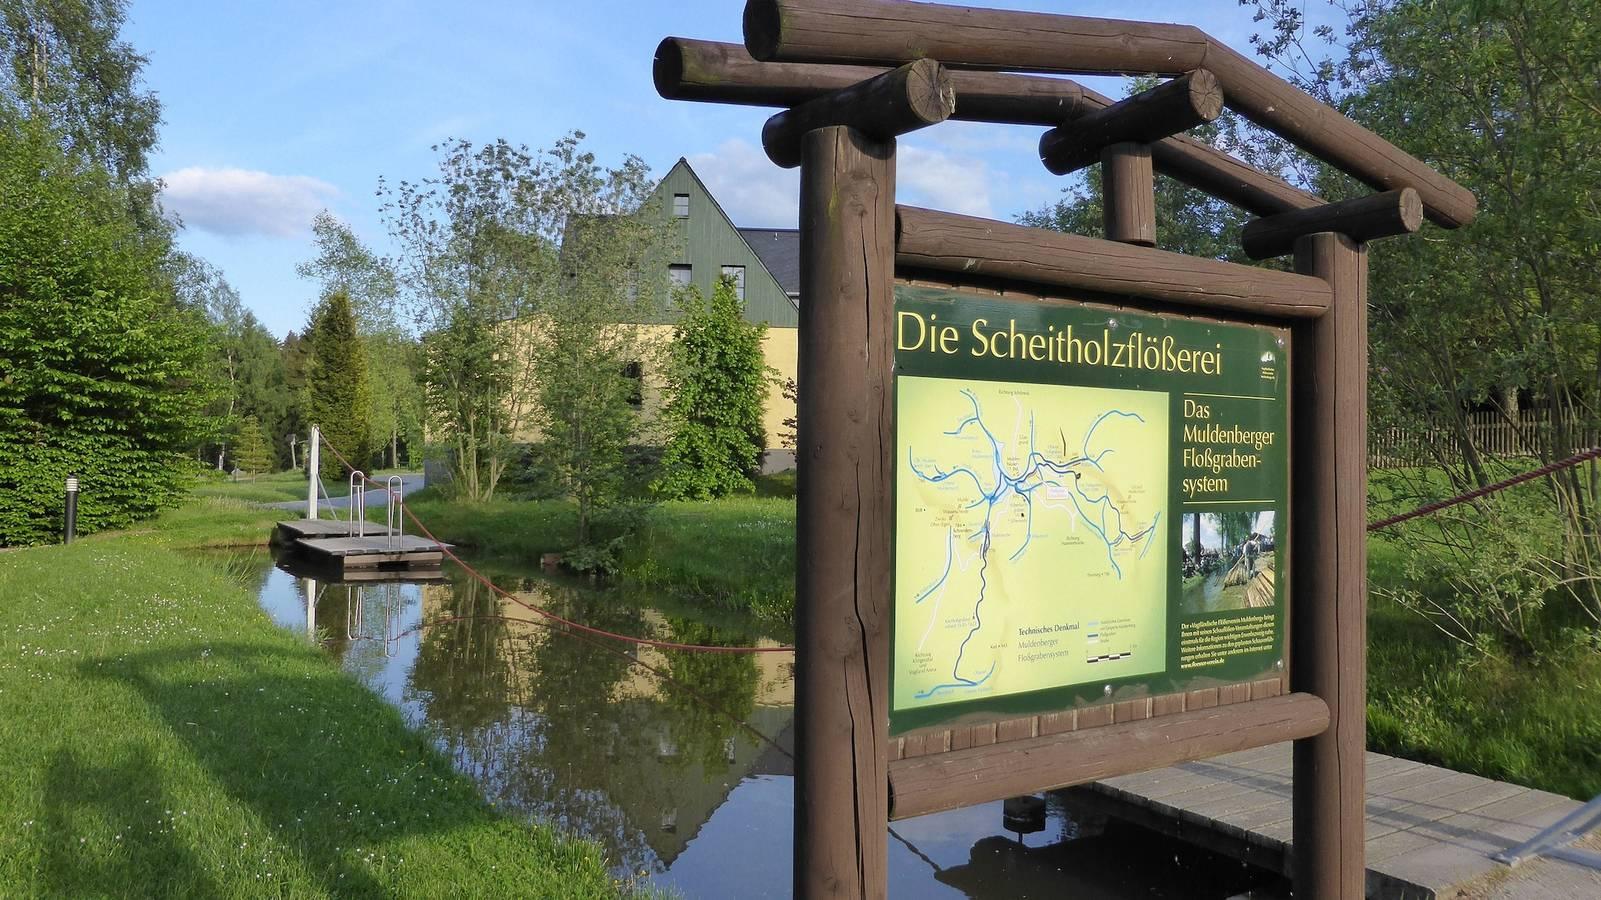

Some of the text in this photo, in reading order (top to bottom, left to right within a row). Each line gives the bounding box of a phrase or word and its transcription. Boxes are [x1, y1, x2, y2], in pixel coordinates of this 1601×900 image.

[896, 311, 1222, 375] Die Scheitholzflößerei
[1184, 399, 1210, 419] Das
[1183, 424, 1275, 451] Muldenberger
[1183, 447, 1262, 474] Floßgraben-
[1182, 476, 1228, 499] system
[1018, 621, 1080, 636] Technisches Denkmal
[1017, 638, 1059, 649] Muldenberger
[1017, 649, 1069, 663] Floßgrabensystem
